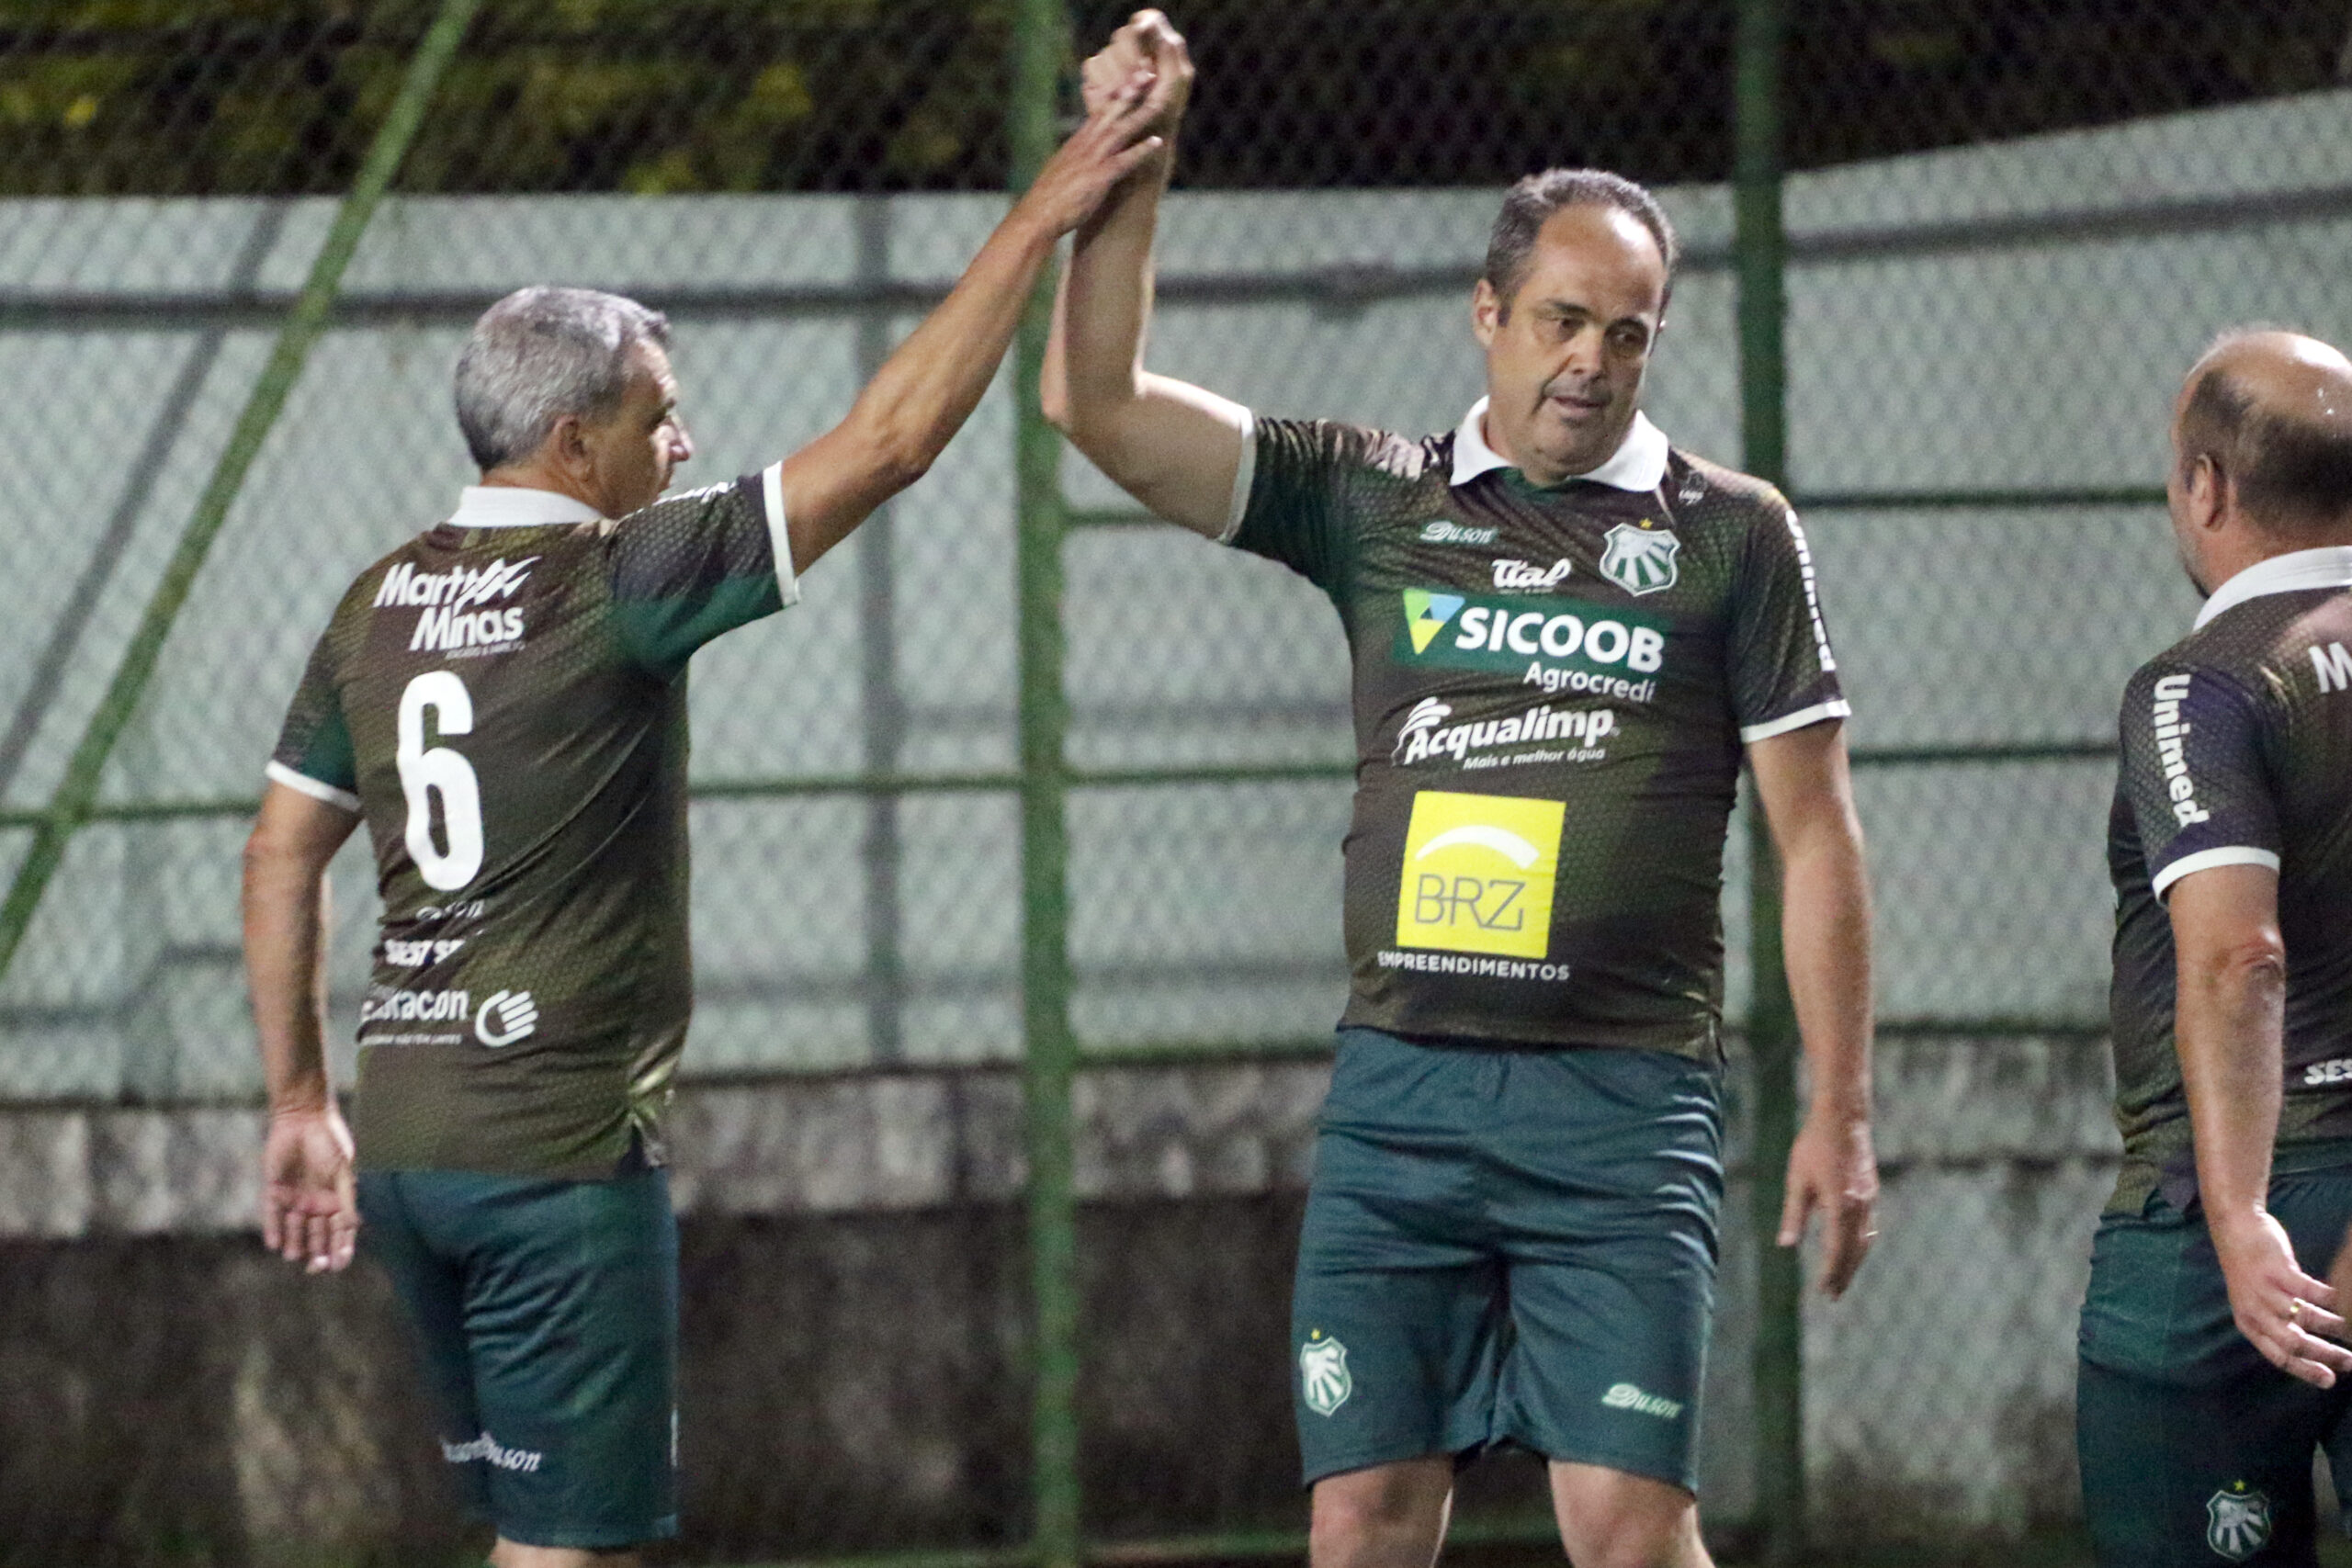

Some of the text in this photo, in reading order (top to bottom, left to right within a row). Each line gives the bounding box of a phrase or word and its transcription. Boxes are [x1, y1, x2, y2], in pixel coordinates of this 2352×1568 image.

[409, 606, 525, 652] Minas
[1455, 606, 1666, 673] SICOOB
[1523, 660, 1657, 703] Agrocredi
[1403, 705, 1614, 766] Acqualimp
[2154, 673, 2211, 828] Unimed
[396, 670, 484, 891] 6
[1415, 874, 1526, 931] BRZ
[1377, 950, 1570, 981] EMPREENDIMENTOS
